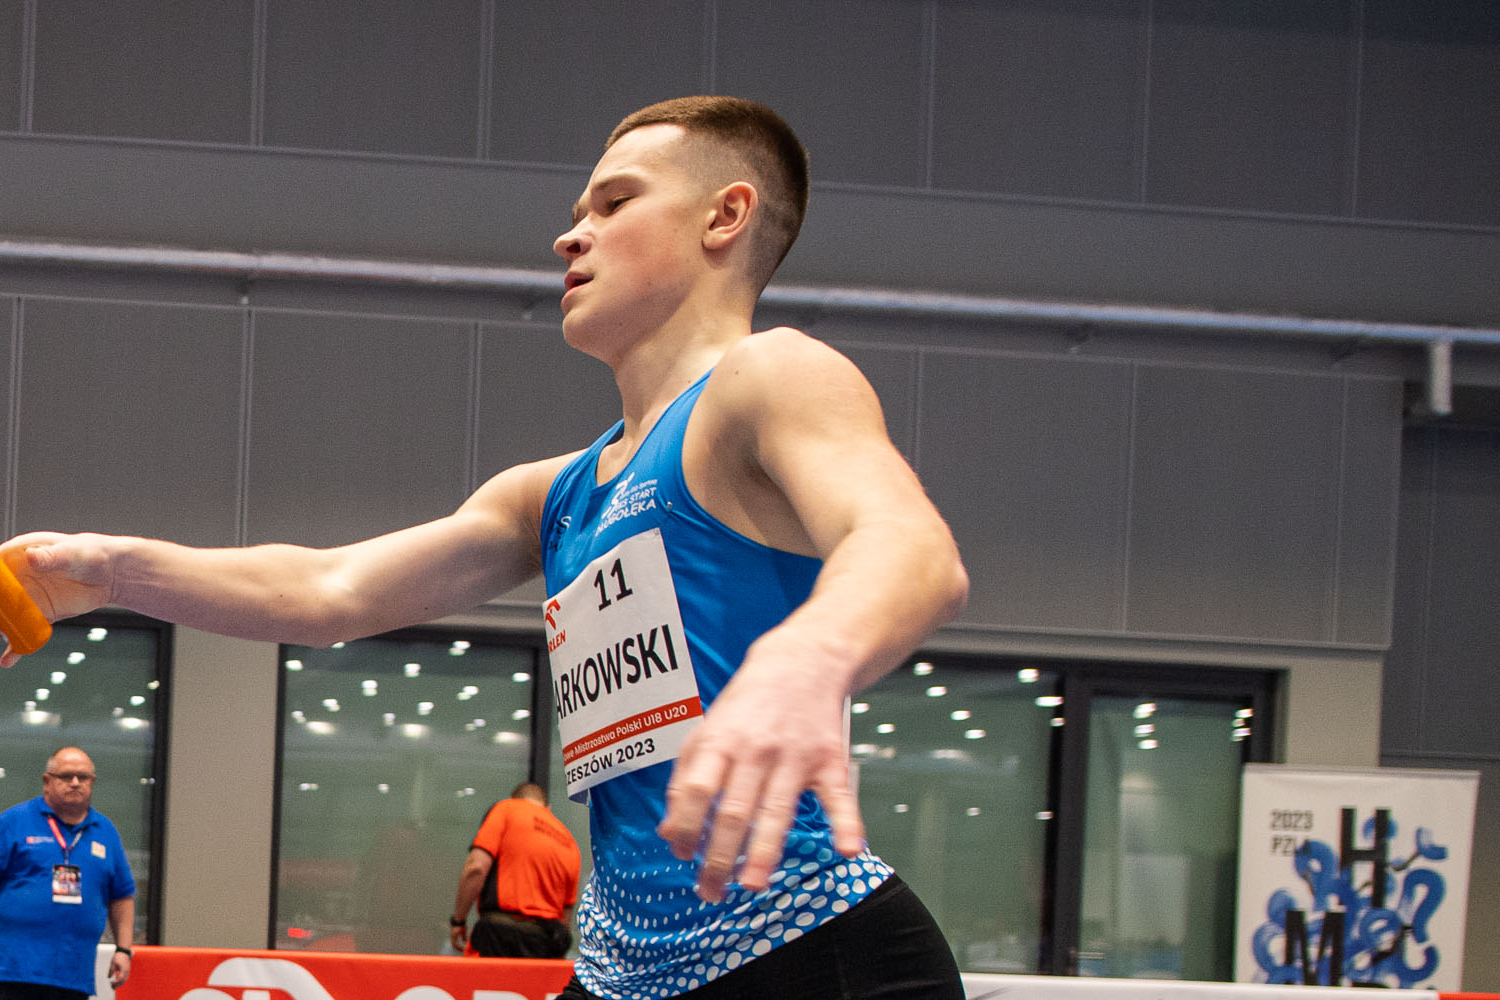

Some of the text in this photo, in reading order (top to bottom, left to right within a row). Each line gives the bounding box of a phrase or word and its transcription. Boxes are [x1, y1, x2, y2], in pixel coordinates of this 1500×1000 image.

[628, 487, 657, 504] START
[593, 558, 633, 611] 11
[574, 731, 615, 756] Mistrzostwa
[615, 719, 642, 737] Polski
[643, 713, 662, 727] U18
[664, 704, 688, 721] U20
[566, 738, 656, 785] ZESZÓW 2023
[1269, 810, 1314, 831] 2023
